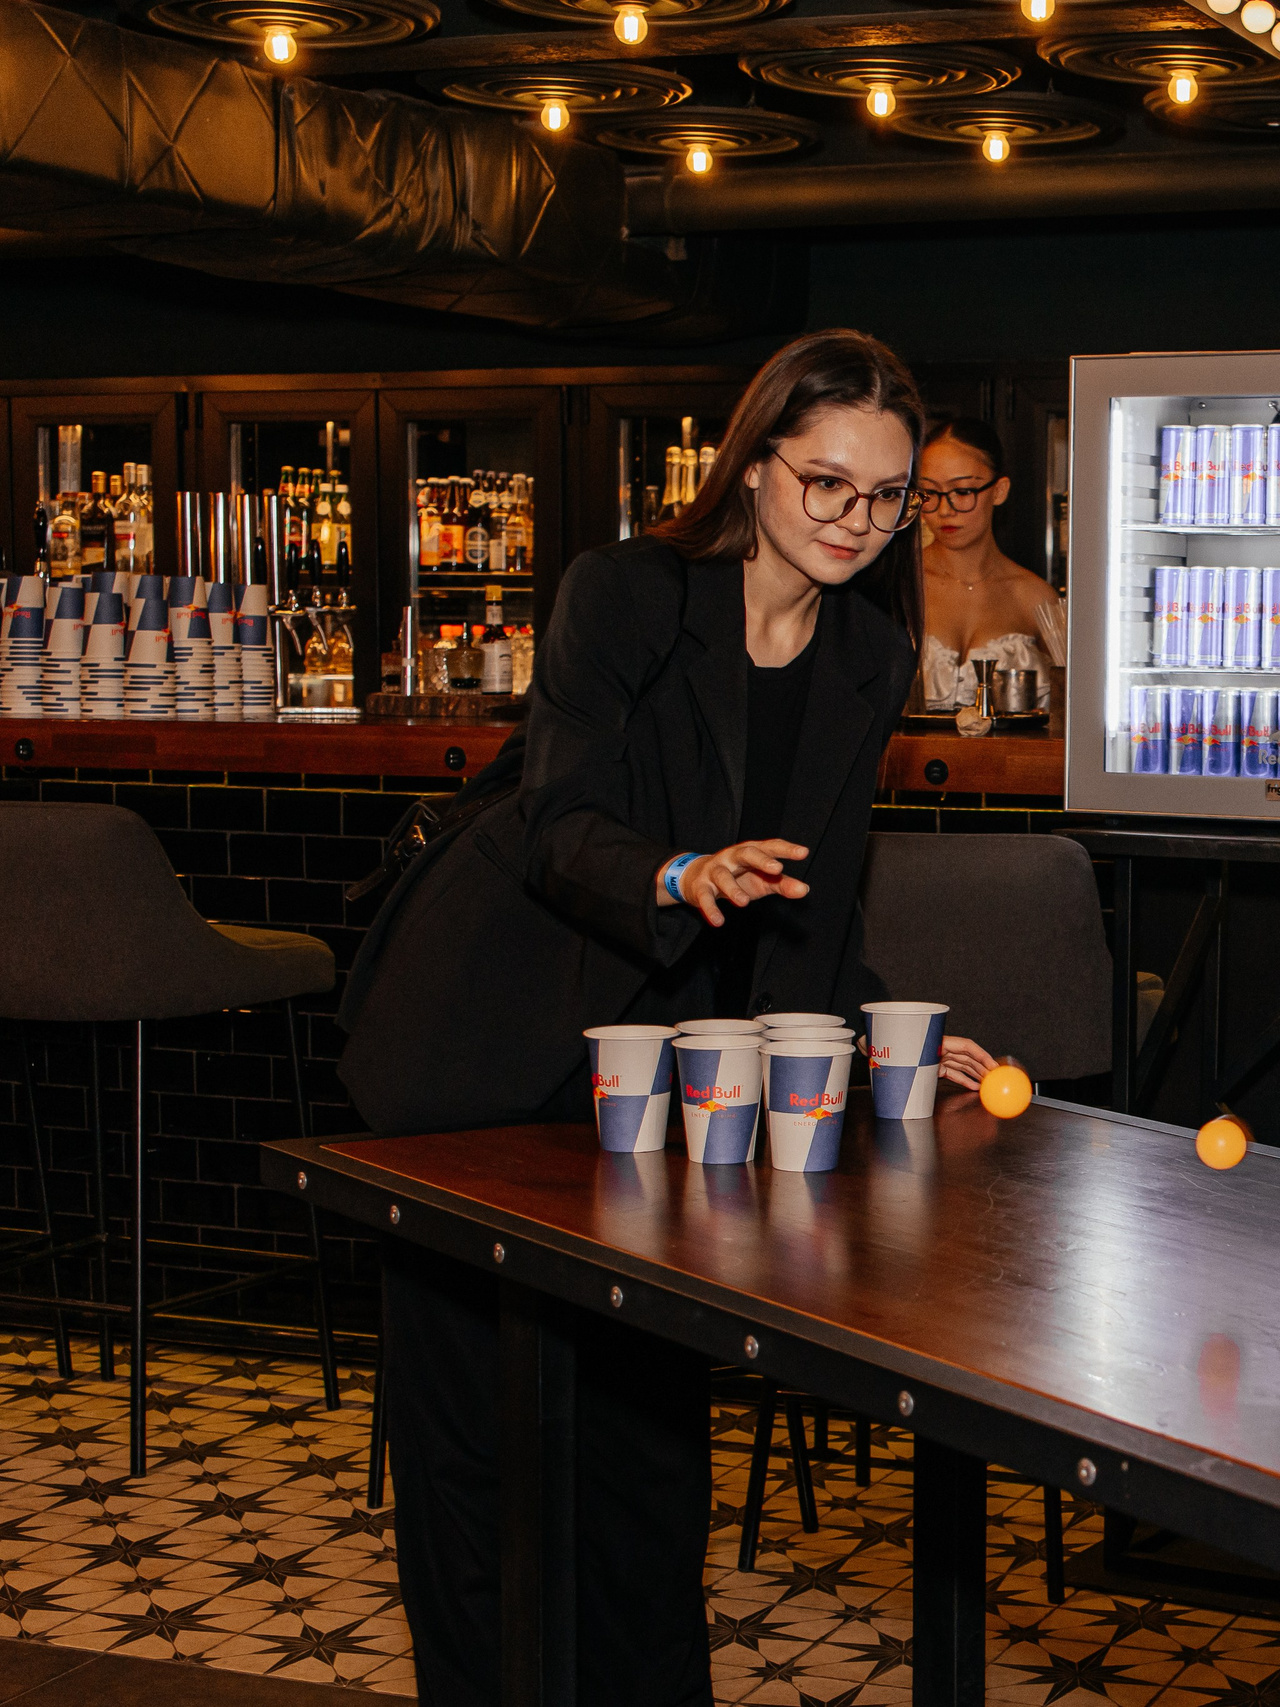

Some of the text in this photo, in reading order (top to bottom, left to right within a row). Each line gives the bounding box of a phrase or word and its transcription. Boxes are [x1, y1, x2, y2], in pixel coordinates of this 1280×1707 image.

[1210, 724, 1232, 736] Bull
[871, 1045, 890, 1058] Bull
[598, 1074, 619, 1087] Bull
[686, 1084, 741, 1099] Red Bull
[789, 1091, 844, 1107] Red Bull
